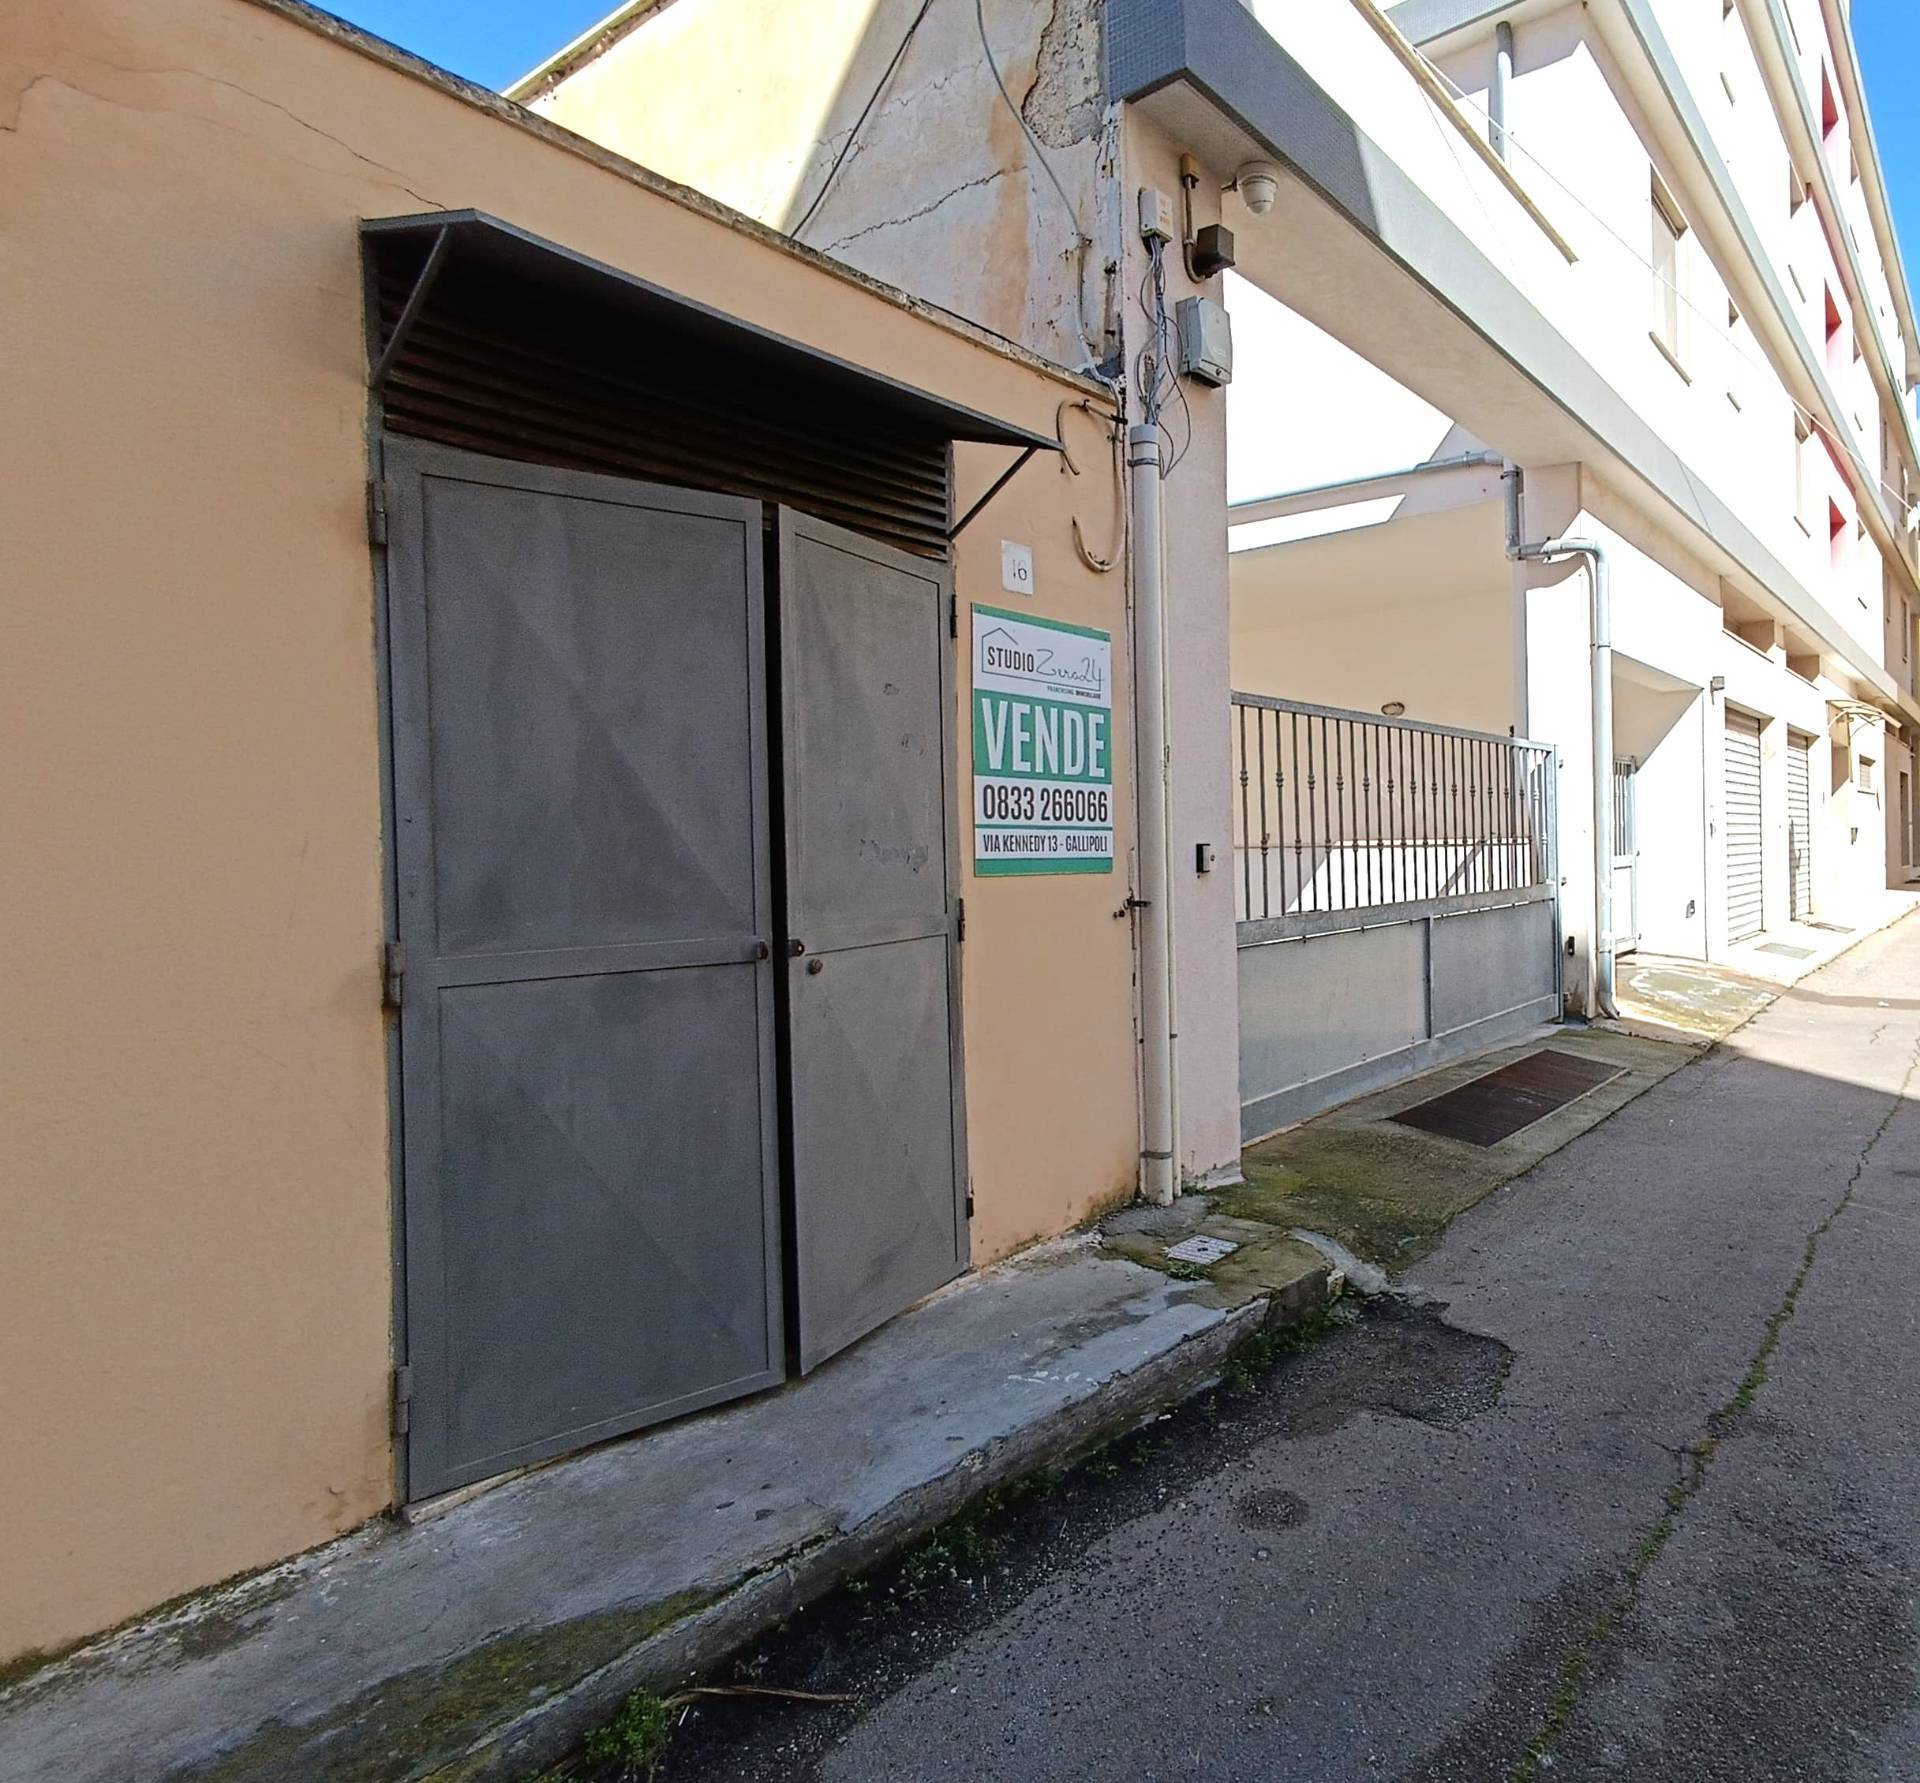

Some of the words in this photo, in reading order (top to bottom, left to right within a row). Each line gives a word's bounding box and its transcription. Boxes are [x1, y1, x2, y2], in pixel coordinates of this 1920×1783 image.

[987, 645, 1034, 673] STUDIO
[981, 698, 1105, 778] VENDE
[983, 784, 1034, 821] 0833
[1040, 788, 1108, 822] 266066
[983, 834, 1001, 853] VIA
[1003, 834, 1046, 853] KENNEDY
[1048, 835, 1058, 853] 13
[1066, 835, 1108, 852] GALLIPOLI
